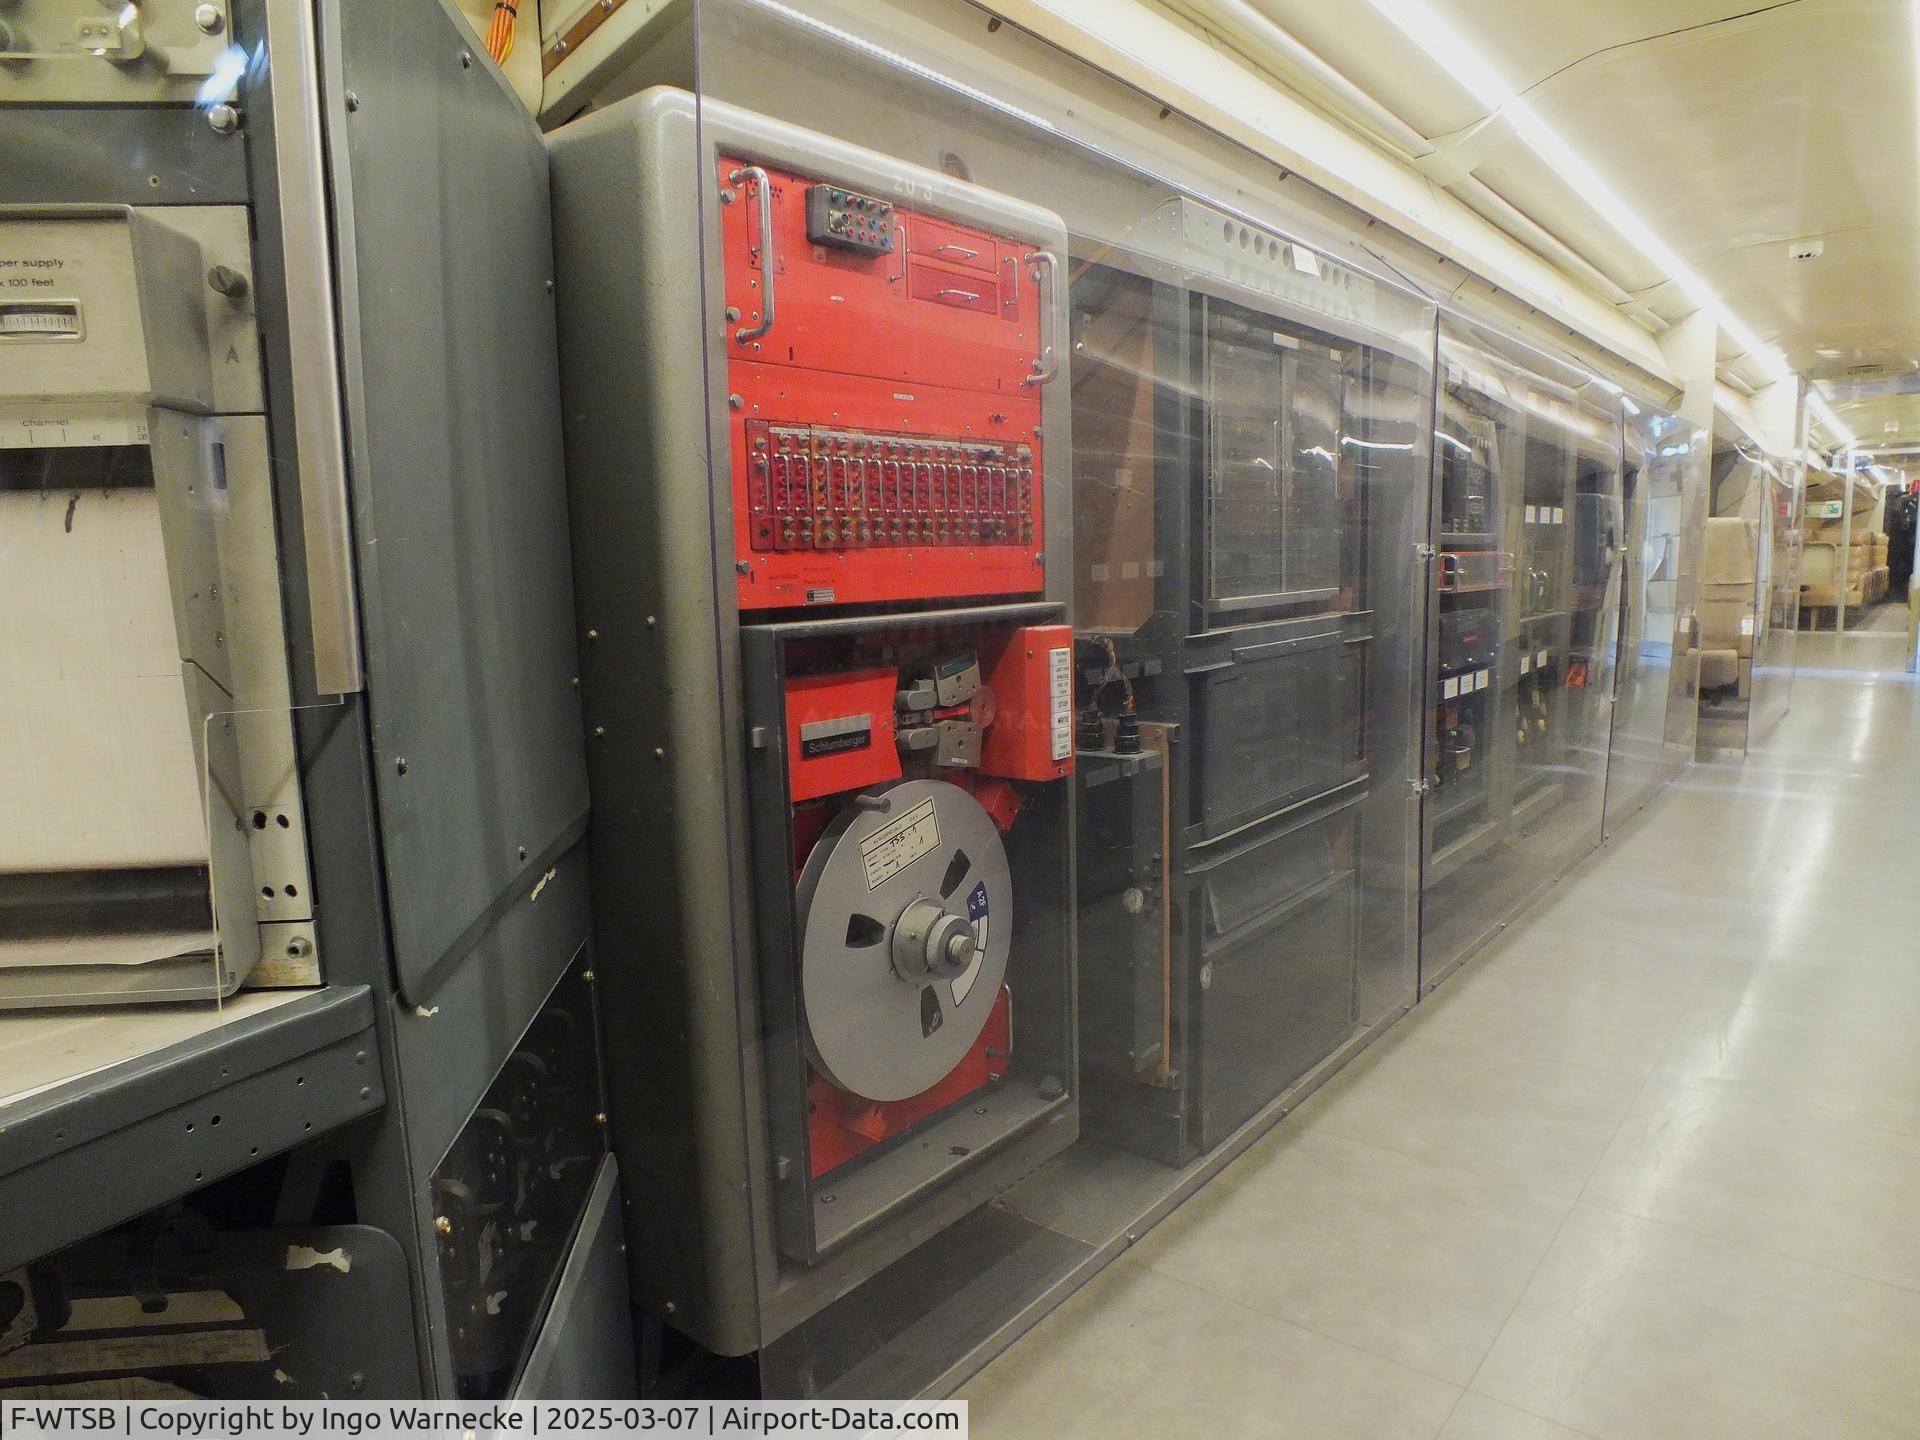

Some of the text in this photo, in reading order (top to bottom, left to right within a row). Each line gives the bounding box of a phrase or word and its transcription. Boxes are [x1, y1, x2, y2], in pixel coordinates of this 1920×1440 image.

[22, 258, 64, 269] supply
[9, 278, 28, 288] 100
[31, 278, 55, 287] feet
[225, 345, 240, 364] A
[22, 418, 69, 427] channel
[808, 735, 866, 753] Schlumberger
